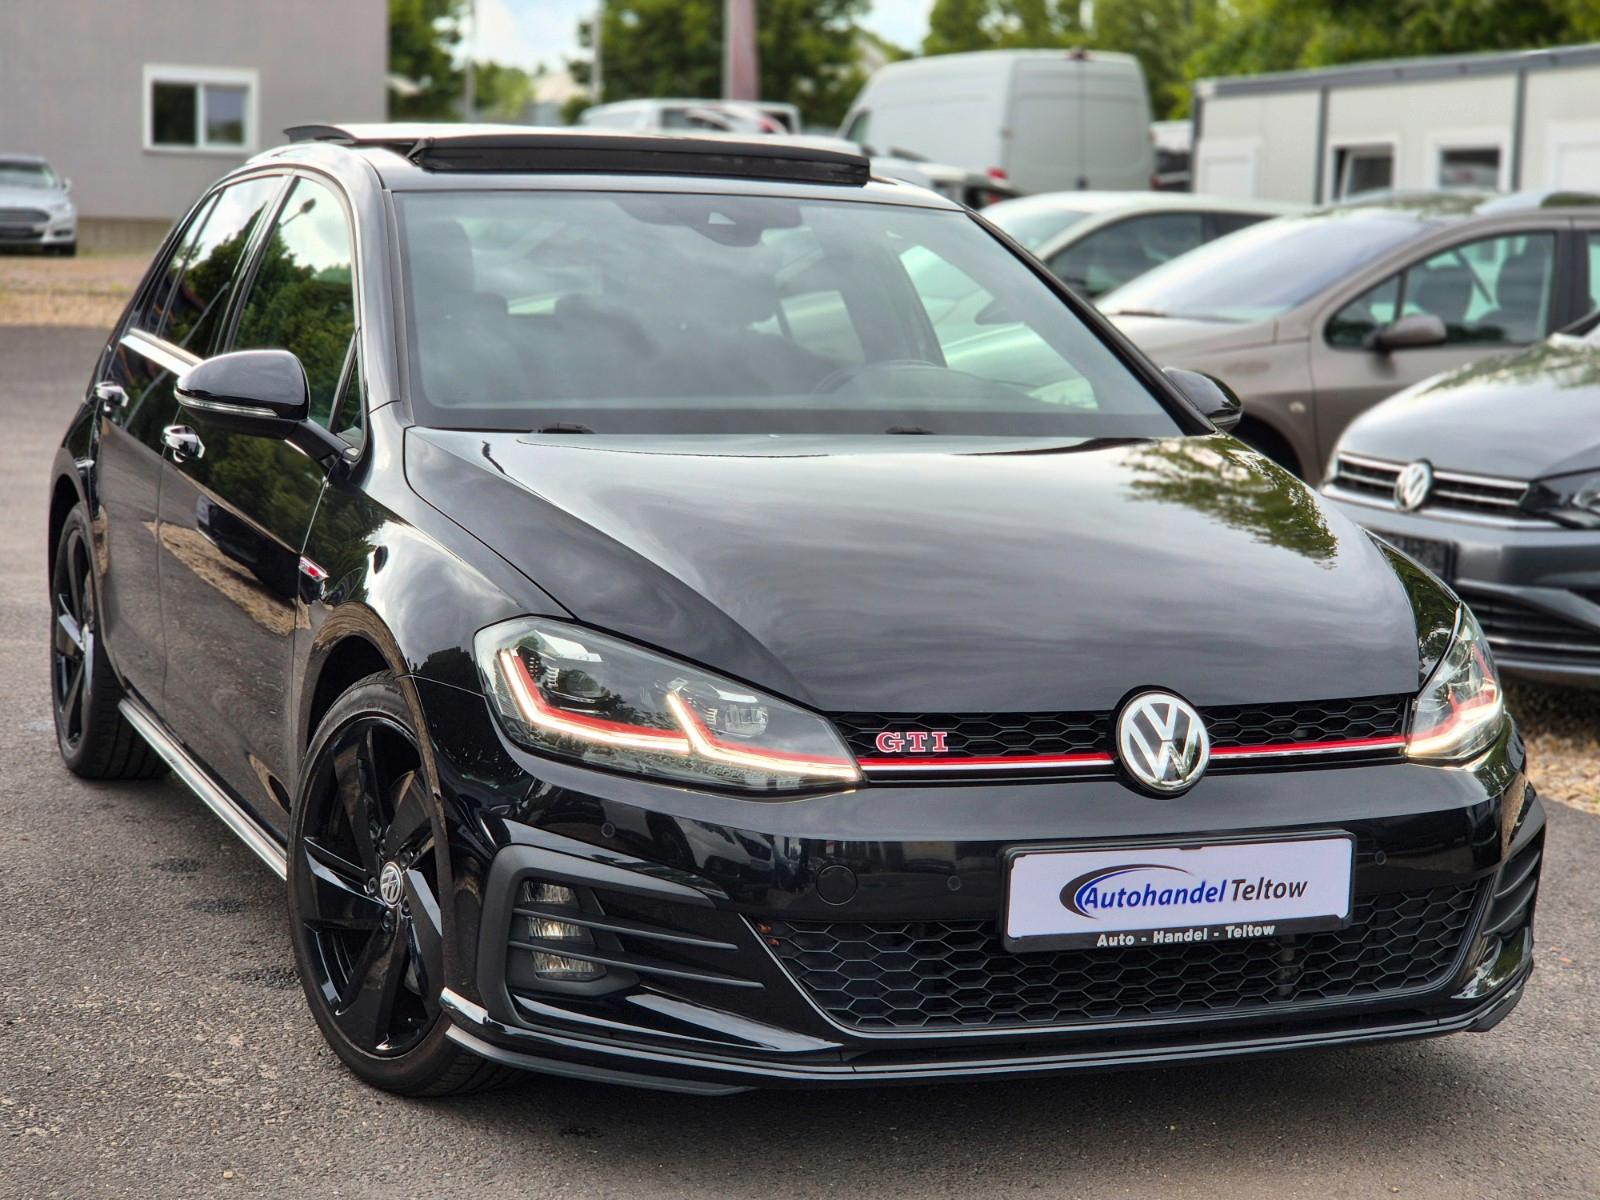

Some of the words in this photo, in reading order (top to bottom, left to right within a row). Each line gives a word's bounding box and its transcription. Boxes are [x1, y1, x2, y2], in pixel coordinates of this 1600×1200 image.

[876, 732, 948, 753] GTI
[1119, 692, 1208, 789] VW
[1084, 879, 1228, 909] Autohandel
[1231, 876, 1308, 902] Teltow
[1096, 933, 1135, 948] Auto
[1153, 927, 1208, 944] Handel
[1225, 924, 1276, 939] Teltow
